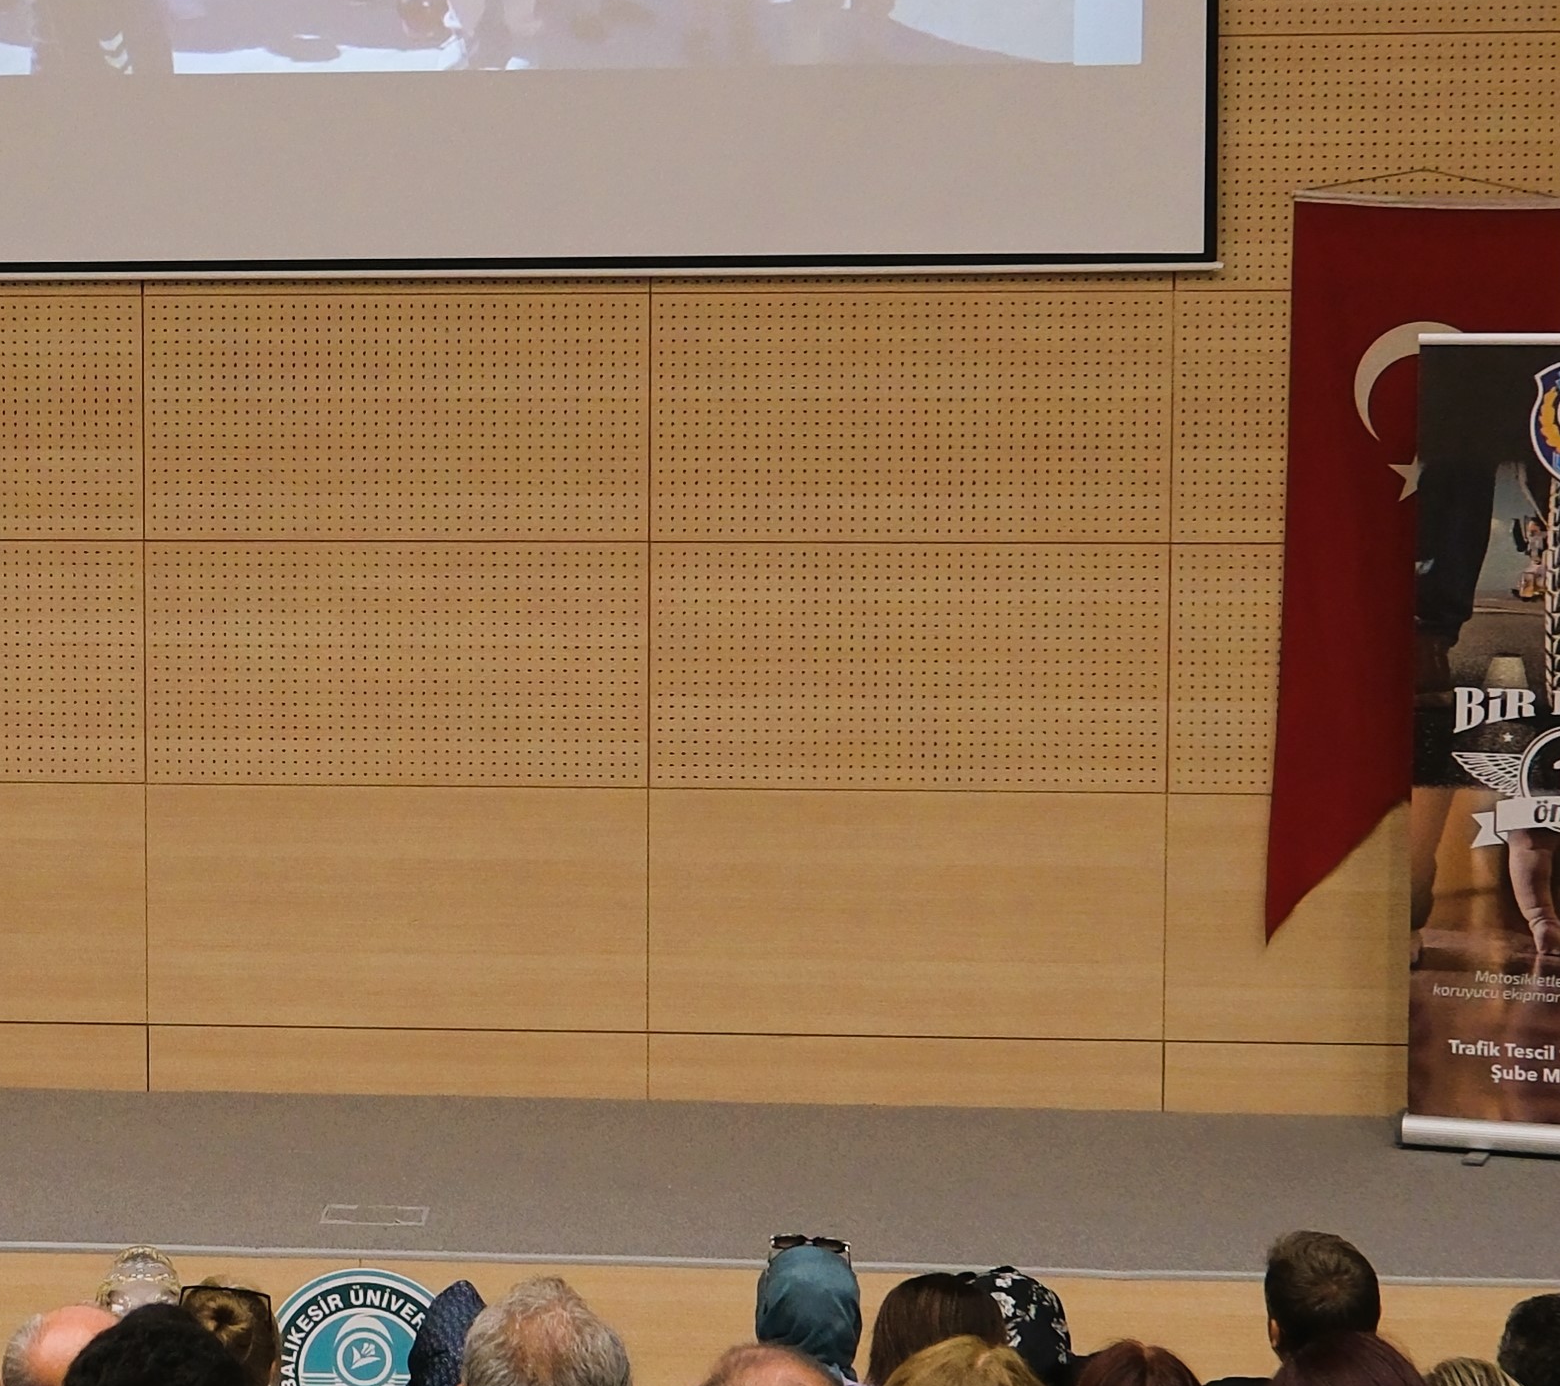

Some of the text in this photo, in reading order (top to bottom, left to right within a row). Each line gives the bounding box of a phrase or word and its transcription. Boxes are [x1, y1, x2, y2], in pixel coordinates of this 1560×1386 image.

[1432, 983, 1499, 1001] koruyucu
[1448, 1039, 1501, 1057] Trafik
[1504, 1043, 1555, 1061] Tescil
[1490, 1064, 1539, 1083] Şube
